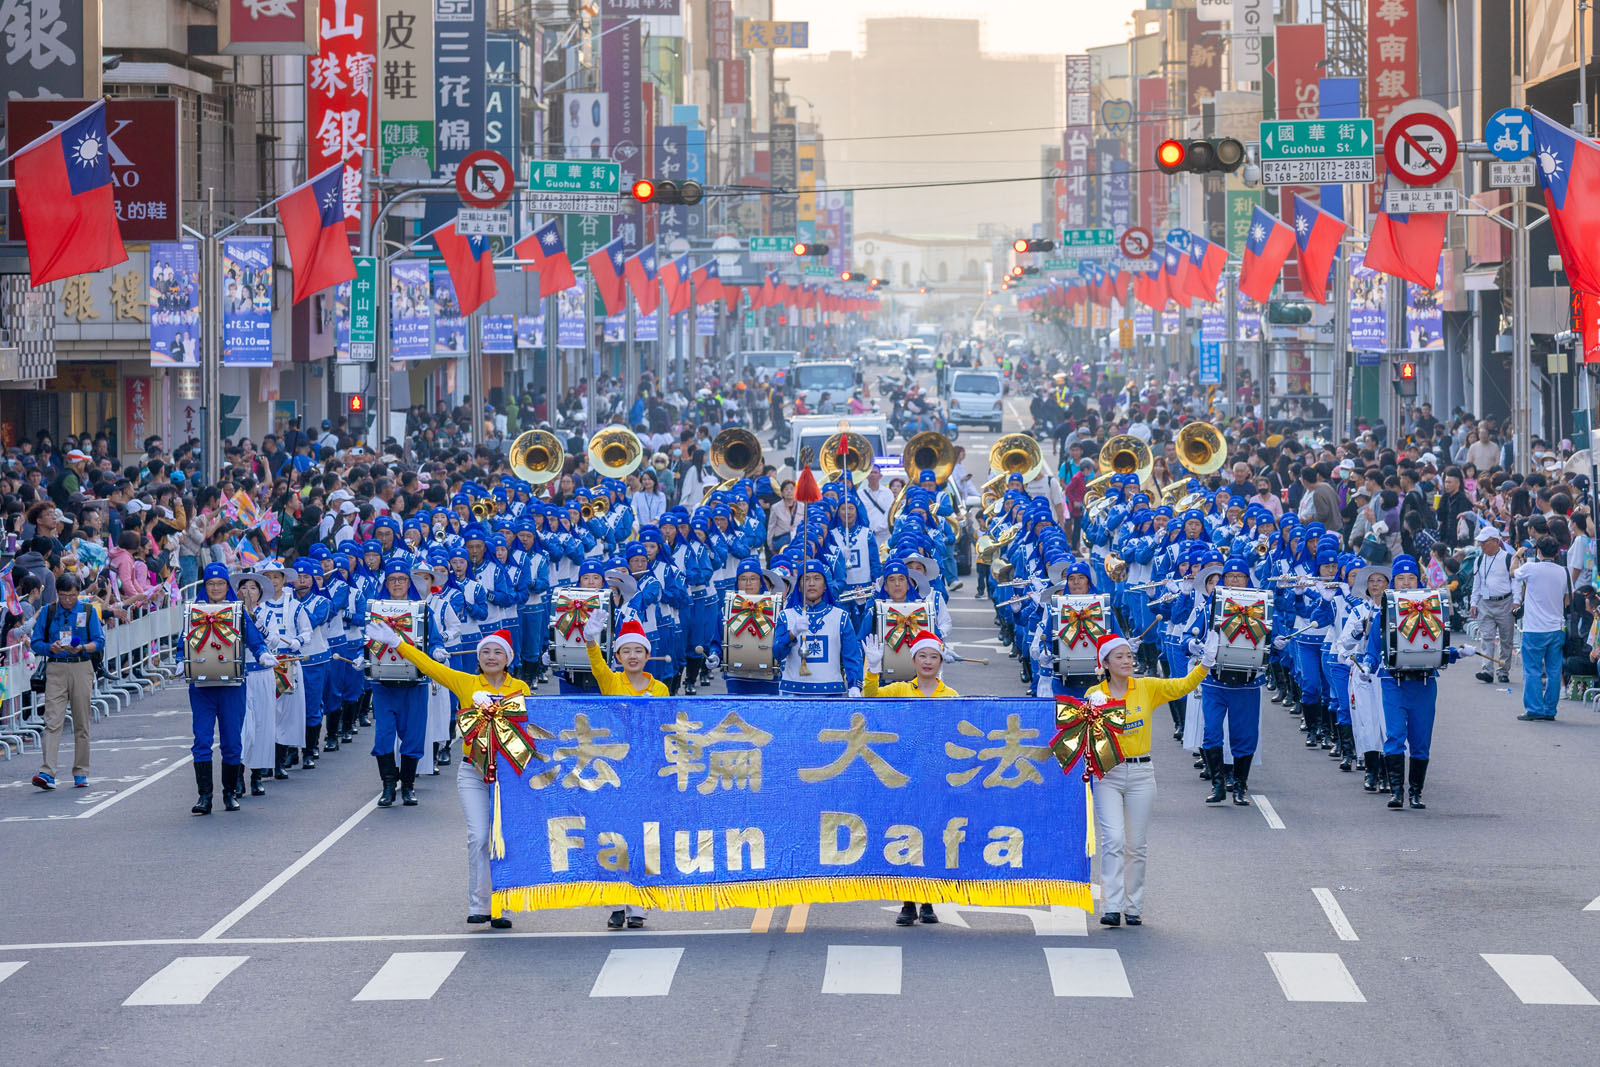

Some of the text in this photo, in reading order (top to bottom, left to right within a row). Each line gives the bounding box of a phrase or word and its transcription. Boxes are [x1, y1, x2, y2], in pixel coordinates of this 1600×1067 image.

[748, 24, 789, 46] 茂昌
[383, 10, 418, 100] 皮鞋
[310, 52, 377, 98] 珠寶
[622, 81, 631, 134] DIAMOND
[383, 124, 420, 145] 健康
[1278, 124, 1355, 141] 國華街
[1281, 143, 1353, 154] Guohua St.
[544, 163, 606, 179] 國華街
[1275, 162, 1316, 171] 241-271
[1320, 161, 1361, 171] 273-283
[546, 179, 582, 189] Guohua
[1275, 171, 1316, 181] 168-200
[1320, 171, 1361, 180] 212-218
[1493, 174, 1531, 183] 兩段左轉
[576, 203, 608, 212] 212-218
[1391, 201, 1453, 212] 禁止右轉
[60, 270, 150, 324] 銀樓
[356, 279, 370, 328] 中山路
[526, 711, 1053, 797] 法輪大法
[547, 811, 1024, 876] Falun Dafa
